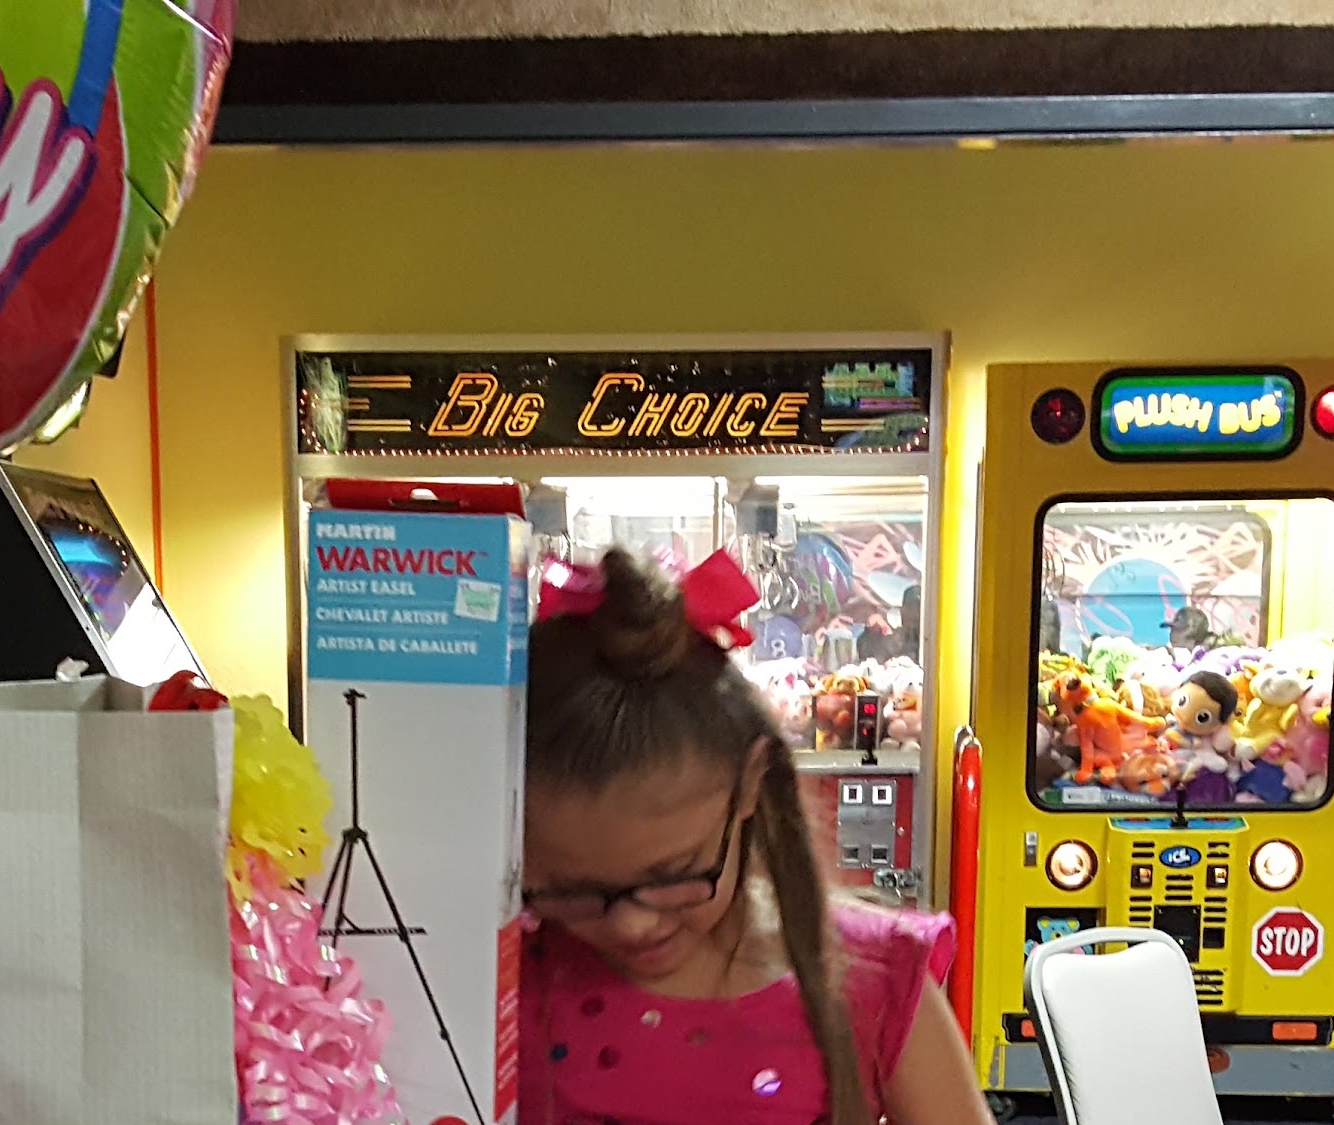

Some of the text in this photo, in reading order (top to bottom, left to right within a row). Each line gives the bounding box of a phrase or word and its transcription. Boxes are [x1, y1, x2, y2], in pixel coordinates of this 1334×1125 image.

[1113, 392, 1282, 435] PLUSH BUS
[315, 523, 397, 541] MARTIN
[317, 578, 417, 596] ARTIST EASEL
[316, 606, 450, 625] CHEVALET ARTISTE
[317, 635, 478, 656] ARTISTA DE CABALLETE
[1260, 926, 1315, 957] STOP
